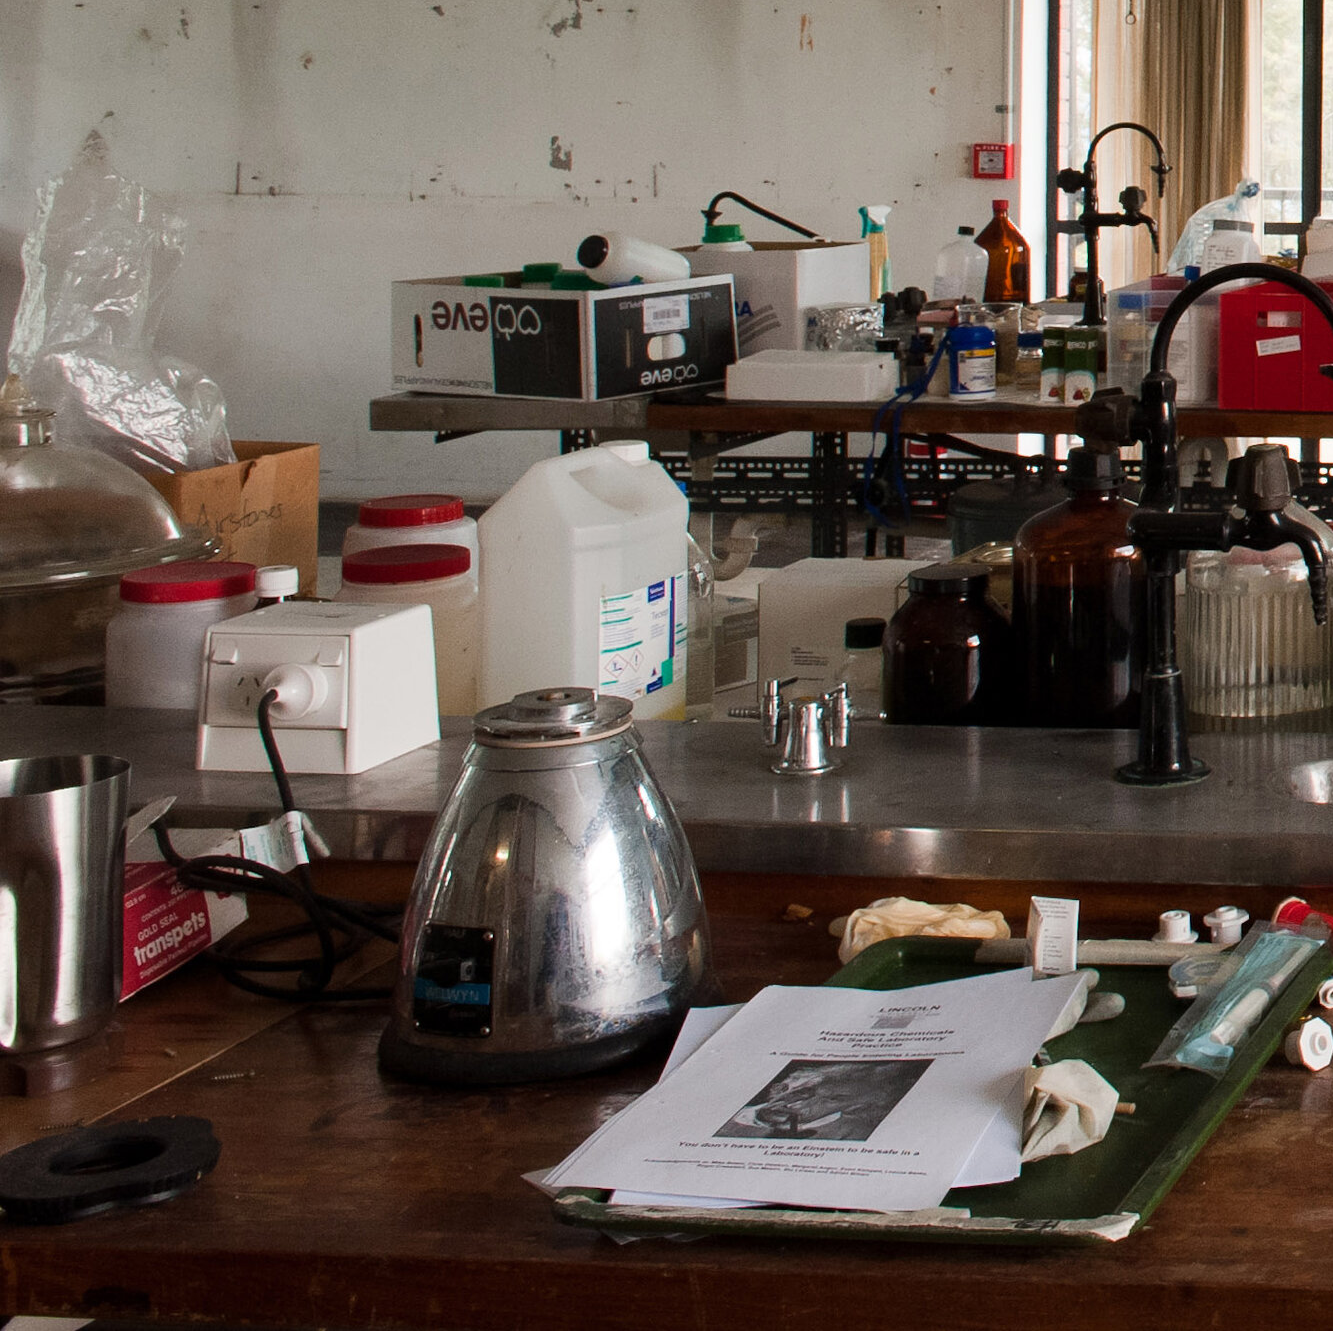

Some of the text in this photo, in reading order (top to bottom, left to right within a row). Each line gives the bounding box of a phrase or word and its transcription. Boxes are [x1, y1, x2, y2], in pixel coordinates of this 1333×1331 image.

[431, 300, 490, 332] eve
[640, 367, 672, 386] eve
[137, 912, 179, 942] GOLD SEAL
[133, 910, 206, 967] transpets
[879, 1004, 942, 1013] LINCOLN
[763, 1149, 826, 1158] Laboratory!
[802, 1145, 845, 1153] Einstein
